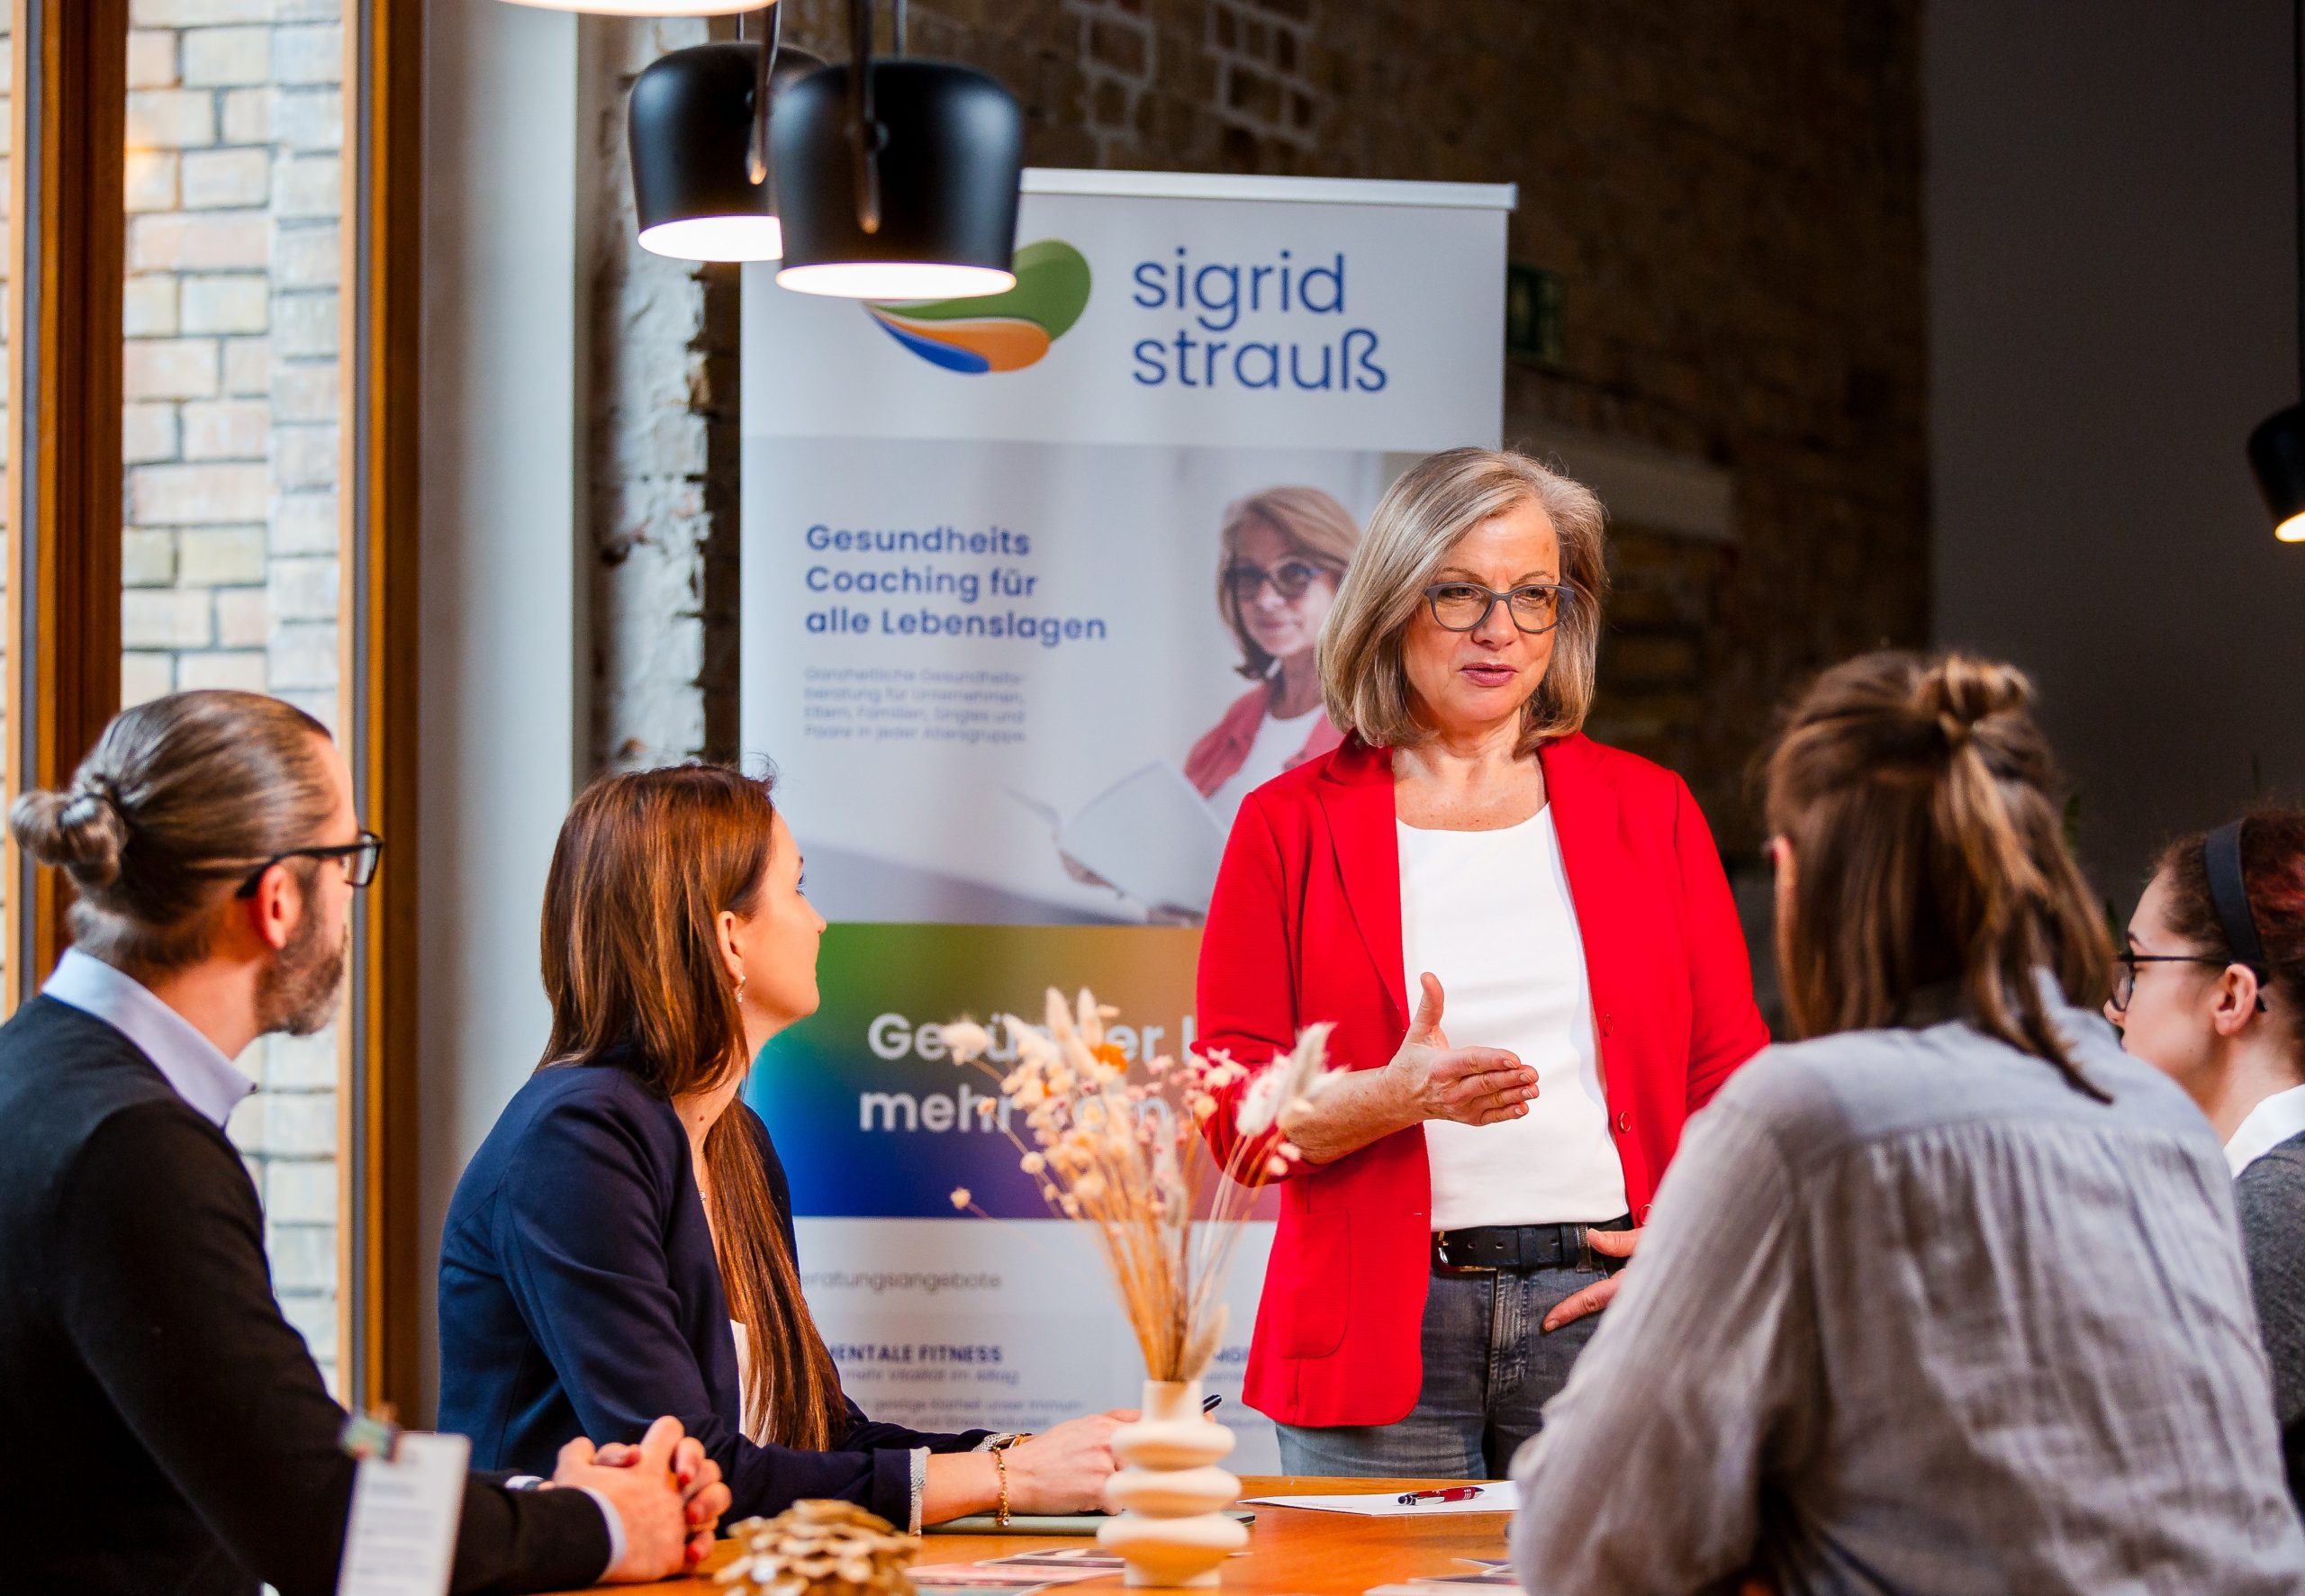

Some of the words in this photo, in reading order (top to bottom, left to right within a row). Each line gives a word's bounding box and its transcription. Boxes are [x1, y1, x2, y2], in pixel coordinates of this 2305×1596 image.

[1133, 246, 1345, 331] sigrid
[1133, 327, 1388, 392] strauß
[806, 525, 1031, 556] Gesundheits
[806, 565, 979, 605] Coaching
[990, 566, 1037, 598] für
[806, 606, 871, 635] alle
[882, 608, 1107, 649] Lebenslagen
[858, 1083, 1016, 1133] mehr
[800, 1269, 1002, 1292] eratungsangebote
[918, 1345, 1003, 1363] FITNESS
